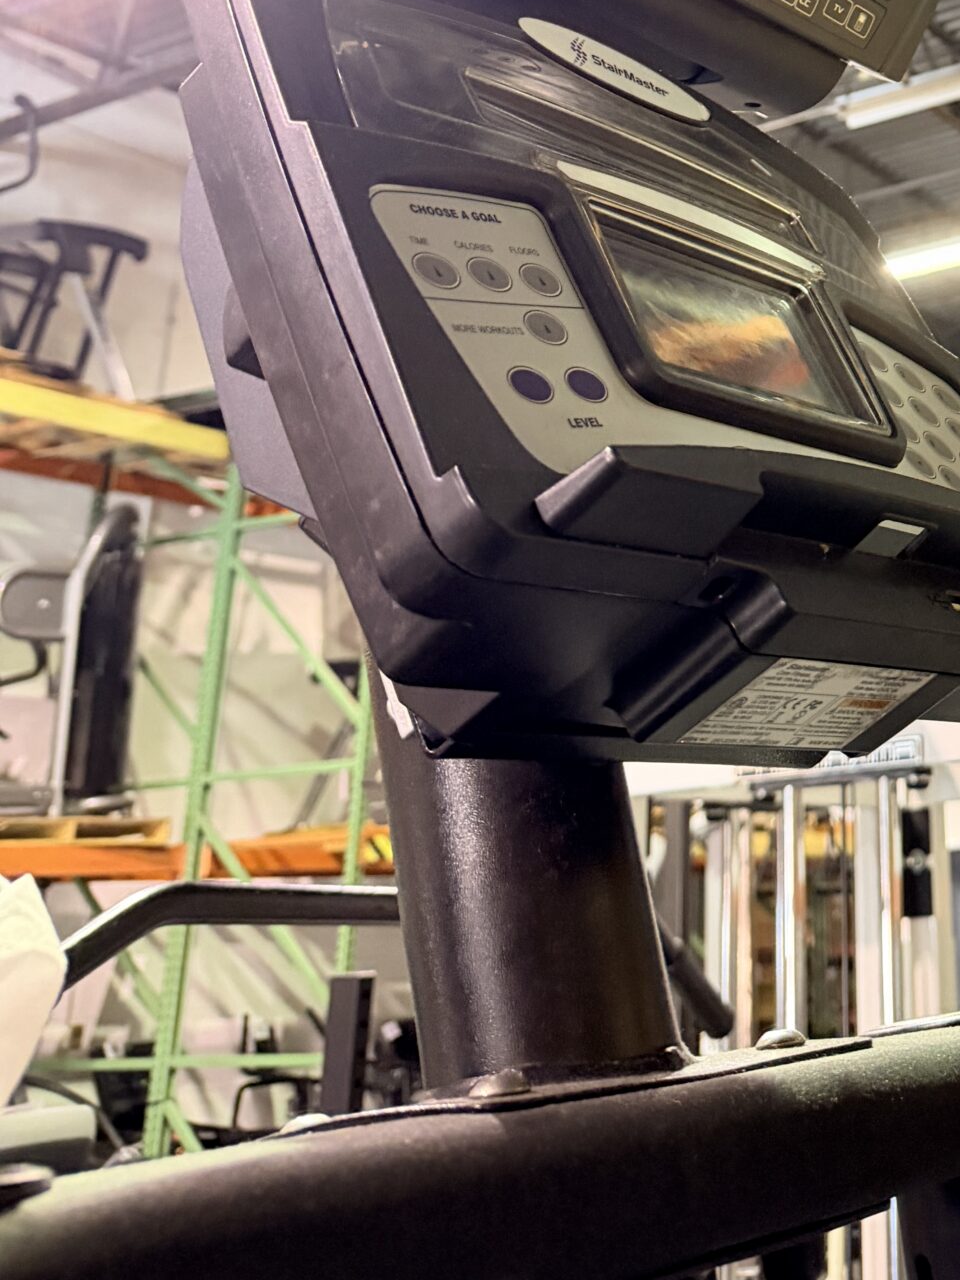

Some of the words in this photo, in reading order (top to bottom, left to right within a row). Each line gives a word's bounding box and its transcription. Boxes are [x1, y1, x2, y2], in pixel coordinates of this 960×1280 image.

[832, 3, 845, 14] TV
[590, 53, 670, 97] StairMaster
[409, 203, 459, 219] CHOOSE
[461, 210, 470, 220] A
[471, 212, 502, 224] GOAL
[453, 240, 494, 253] CALORIES
[508, 246, 540, 257] FLOORS
[567, 417, 603, 428] LEVEL
